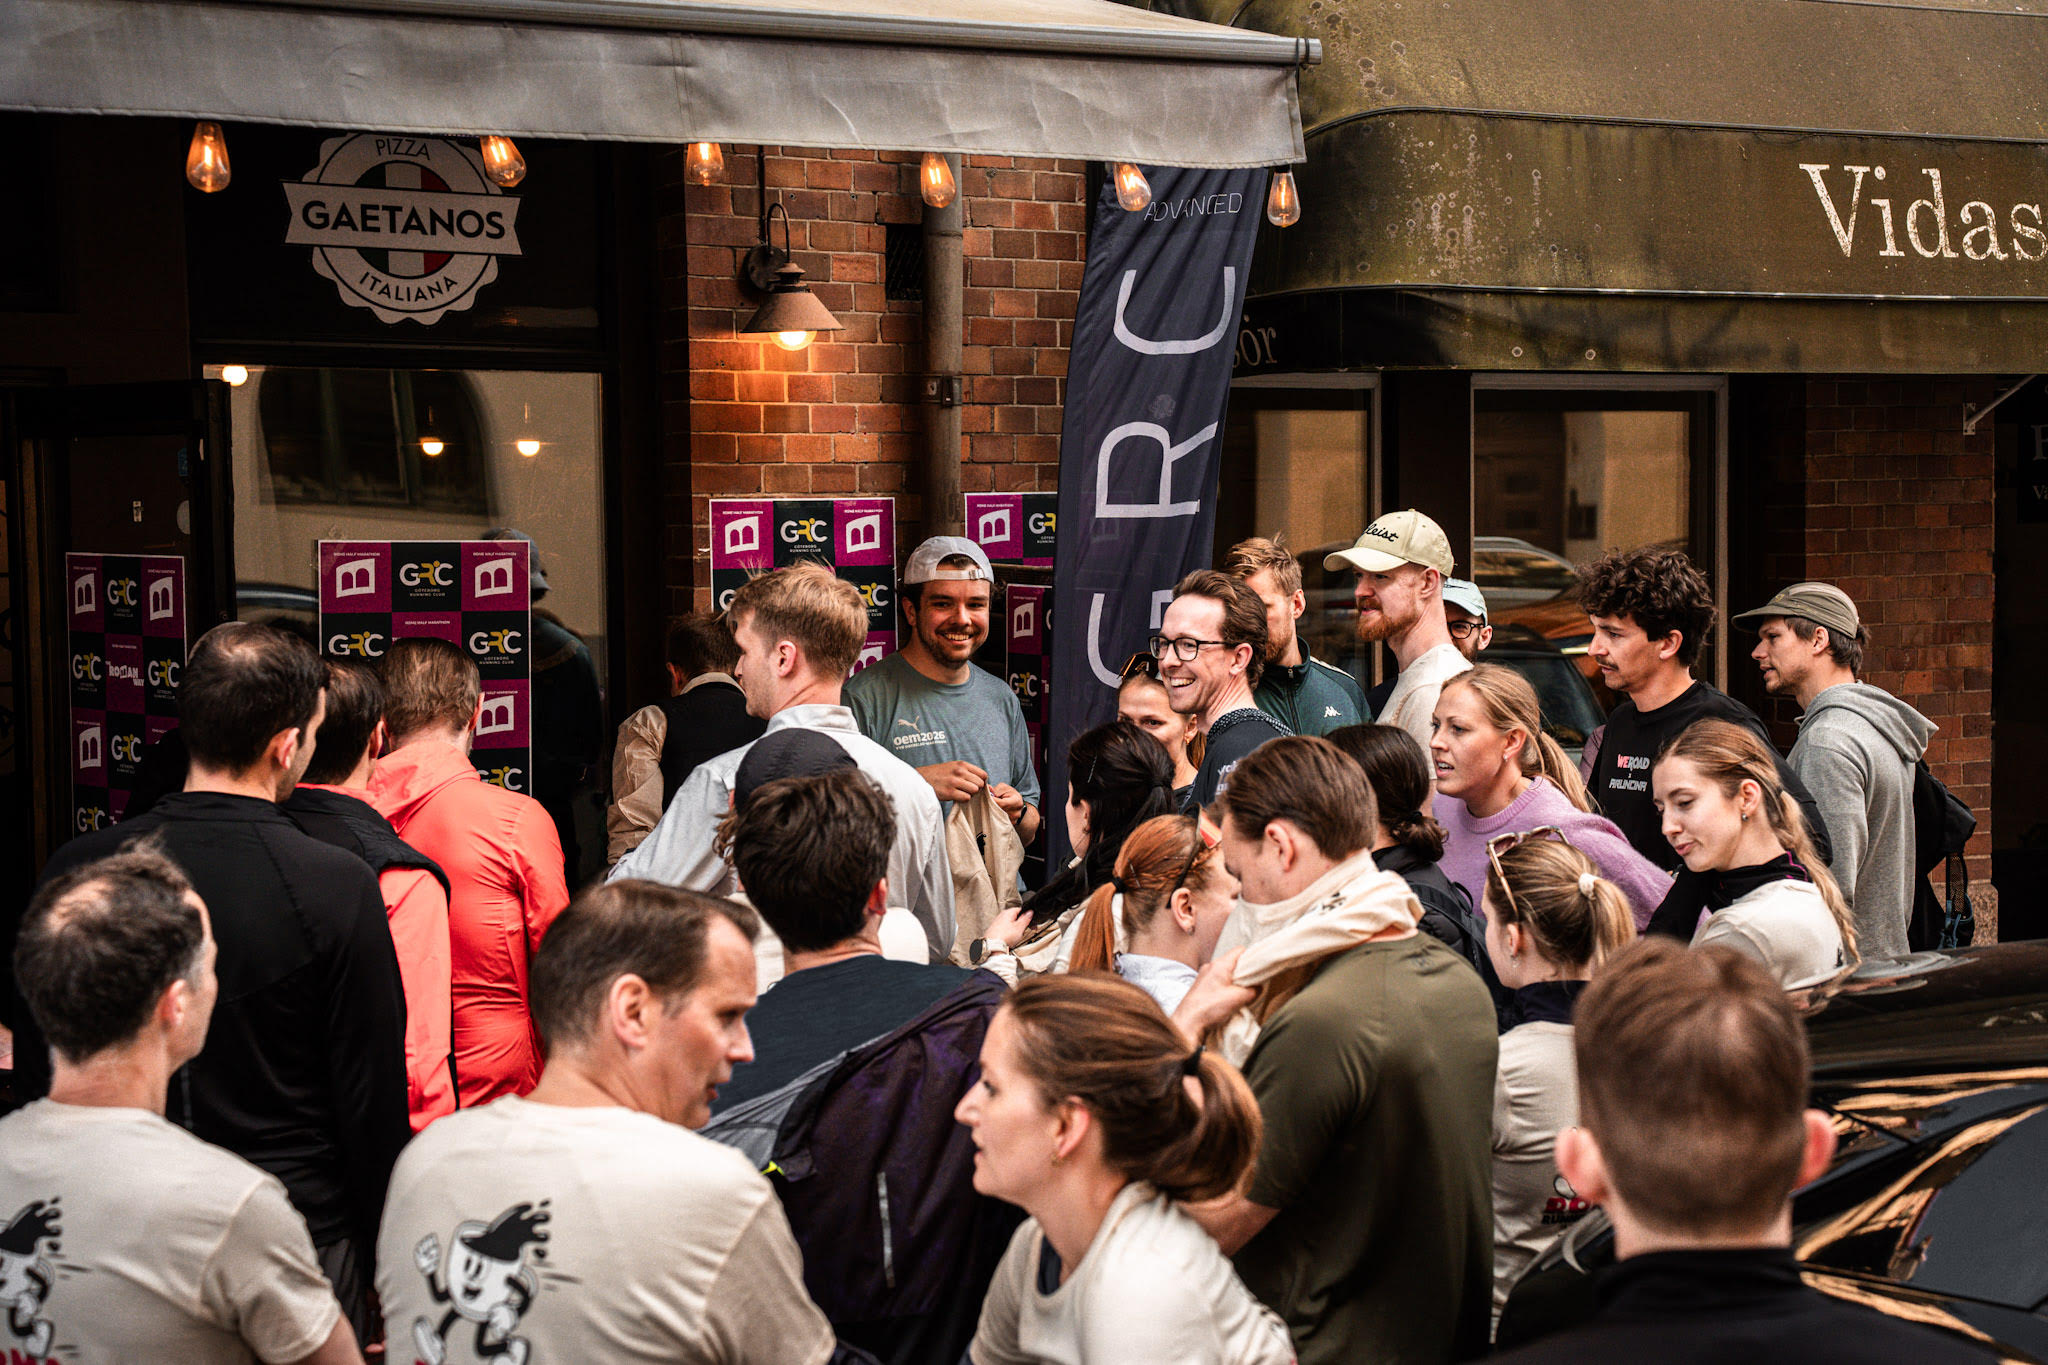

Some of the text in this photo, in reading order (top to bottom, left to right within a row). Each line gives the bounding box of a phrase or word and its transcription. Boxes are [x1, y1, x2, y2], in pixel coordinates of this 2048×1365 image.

[375, 138, 431, 161] PIZZA
[301, 200, 506, 240] GAETANOS
[1143, 192, 1243, 222] ADVANCED
[1798, 163, 2048, 262] Vidas
[359, 271, 458, 303] ITALIANA
[780, 518, 828, 543] GRC
[1028, 513, 1056, 534] GR
[1364, 523, 1399, 543] leist
[400, 560, 454, 587] GRC
[107, 577, 138, 606] GRC
[854, 582, 889, 607] RC
[328, 631, 385, 657] GRC
[469, 628, 522, 655] GRC
[72, 652, 102, 681] GRC
[148, 658, 180, 688] GRC
[1009, 671, 1038, 697] GRC
[111, 733, 142, 763] GRC
[893, 730, 946, 746] oem2026
[77, 806, 106, 833] GRC
